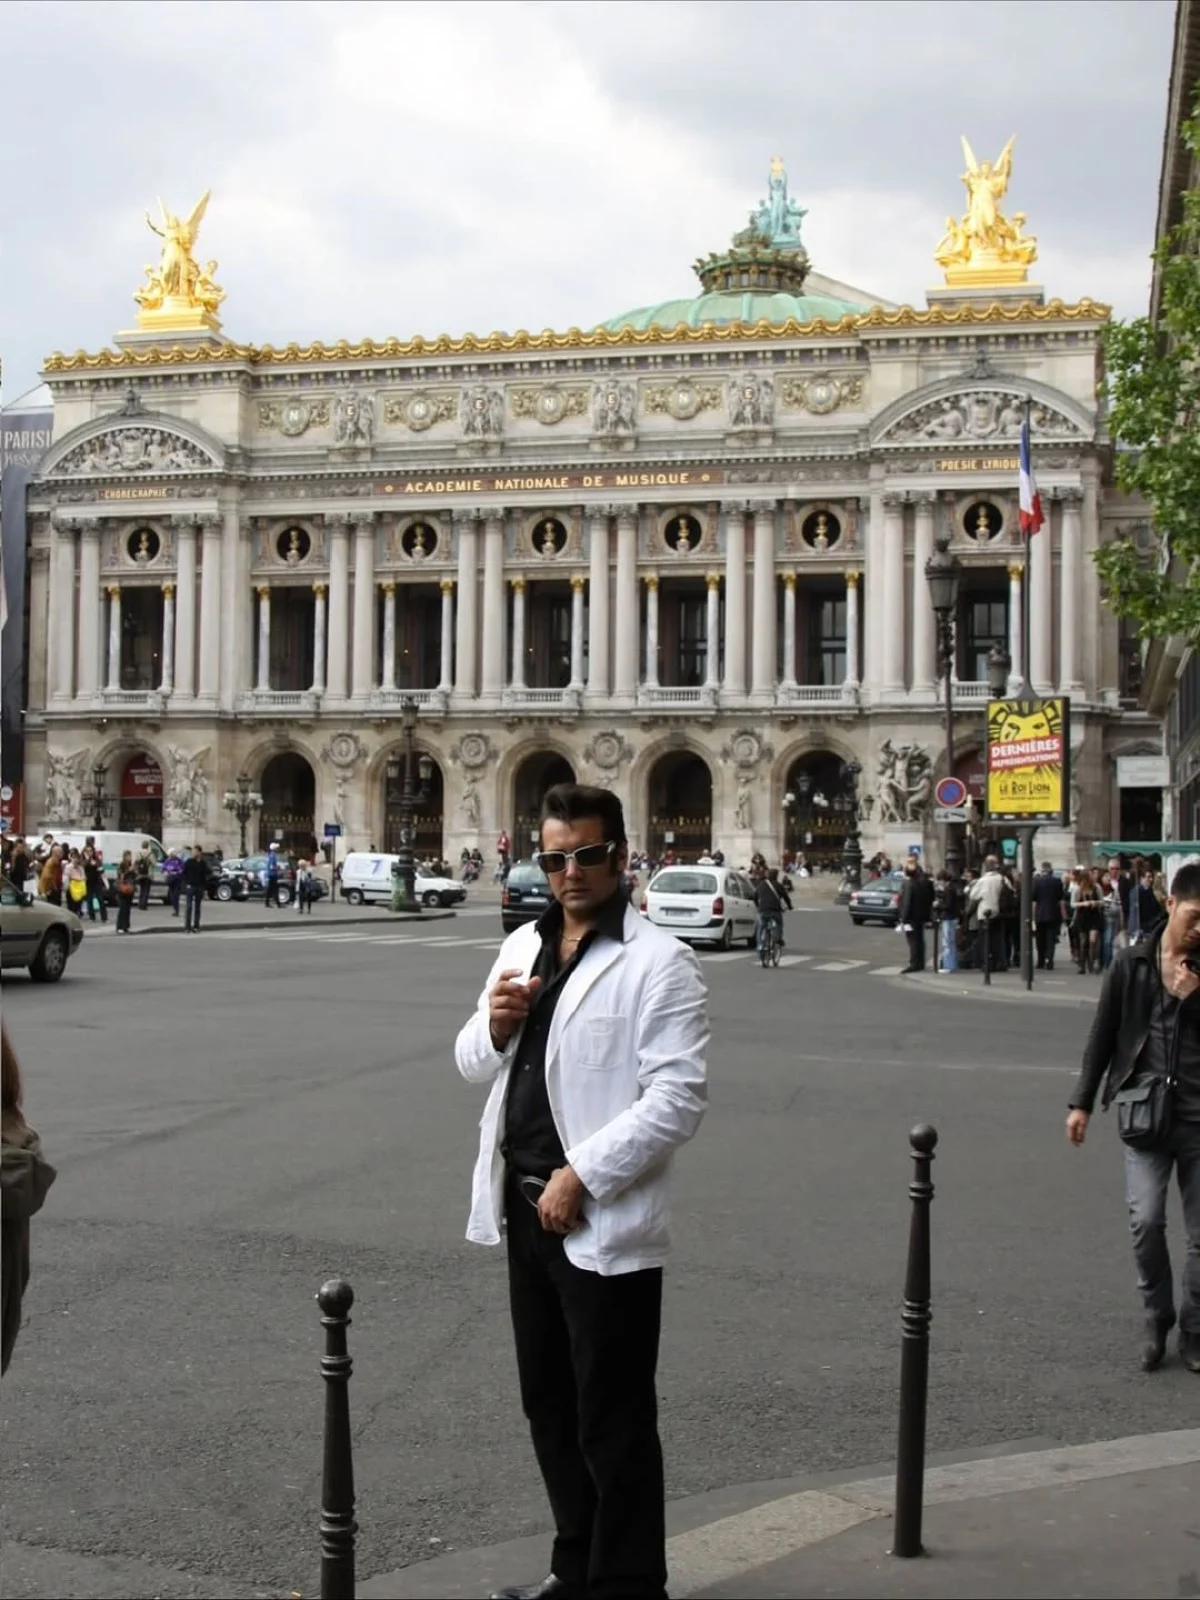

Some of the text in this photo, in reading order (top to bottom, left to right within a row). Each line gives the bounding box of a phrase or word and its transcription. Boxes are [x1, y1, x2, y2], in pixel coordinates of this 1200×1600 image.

[404, 472, 690, 493] ACADEMIE NATIONALE DE MUSIQUE
[991, 738, 1060, 758] DERNIÈRES
